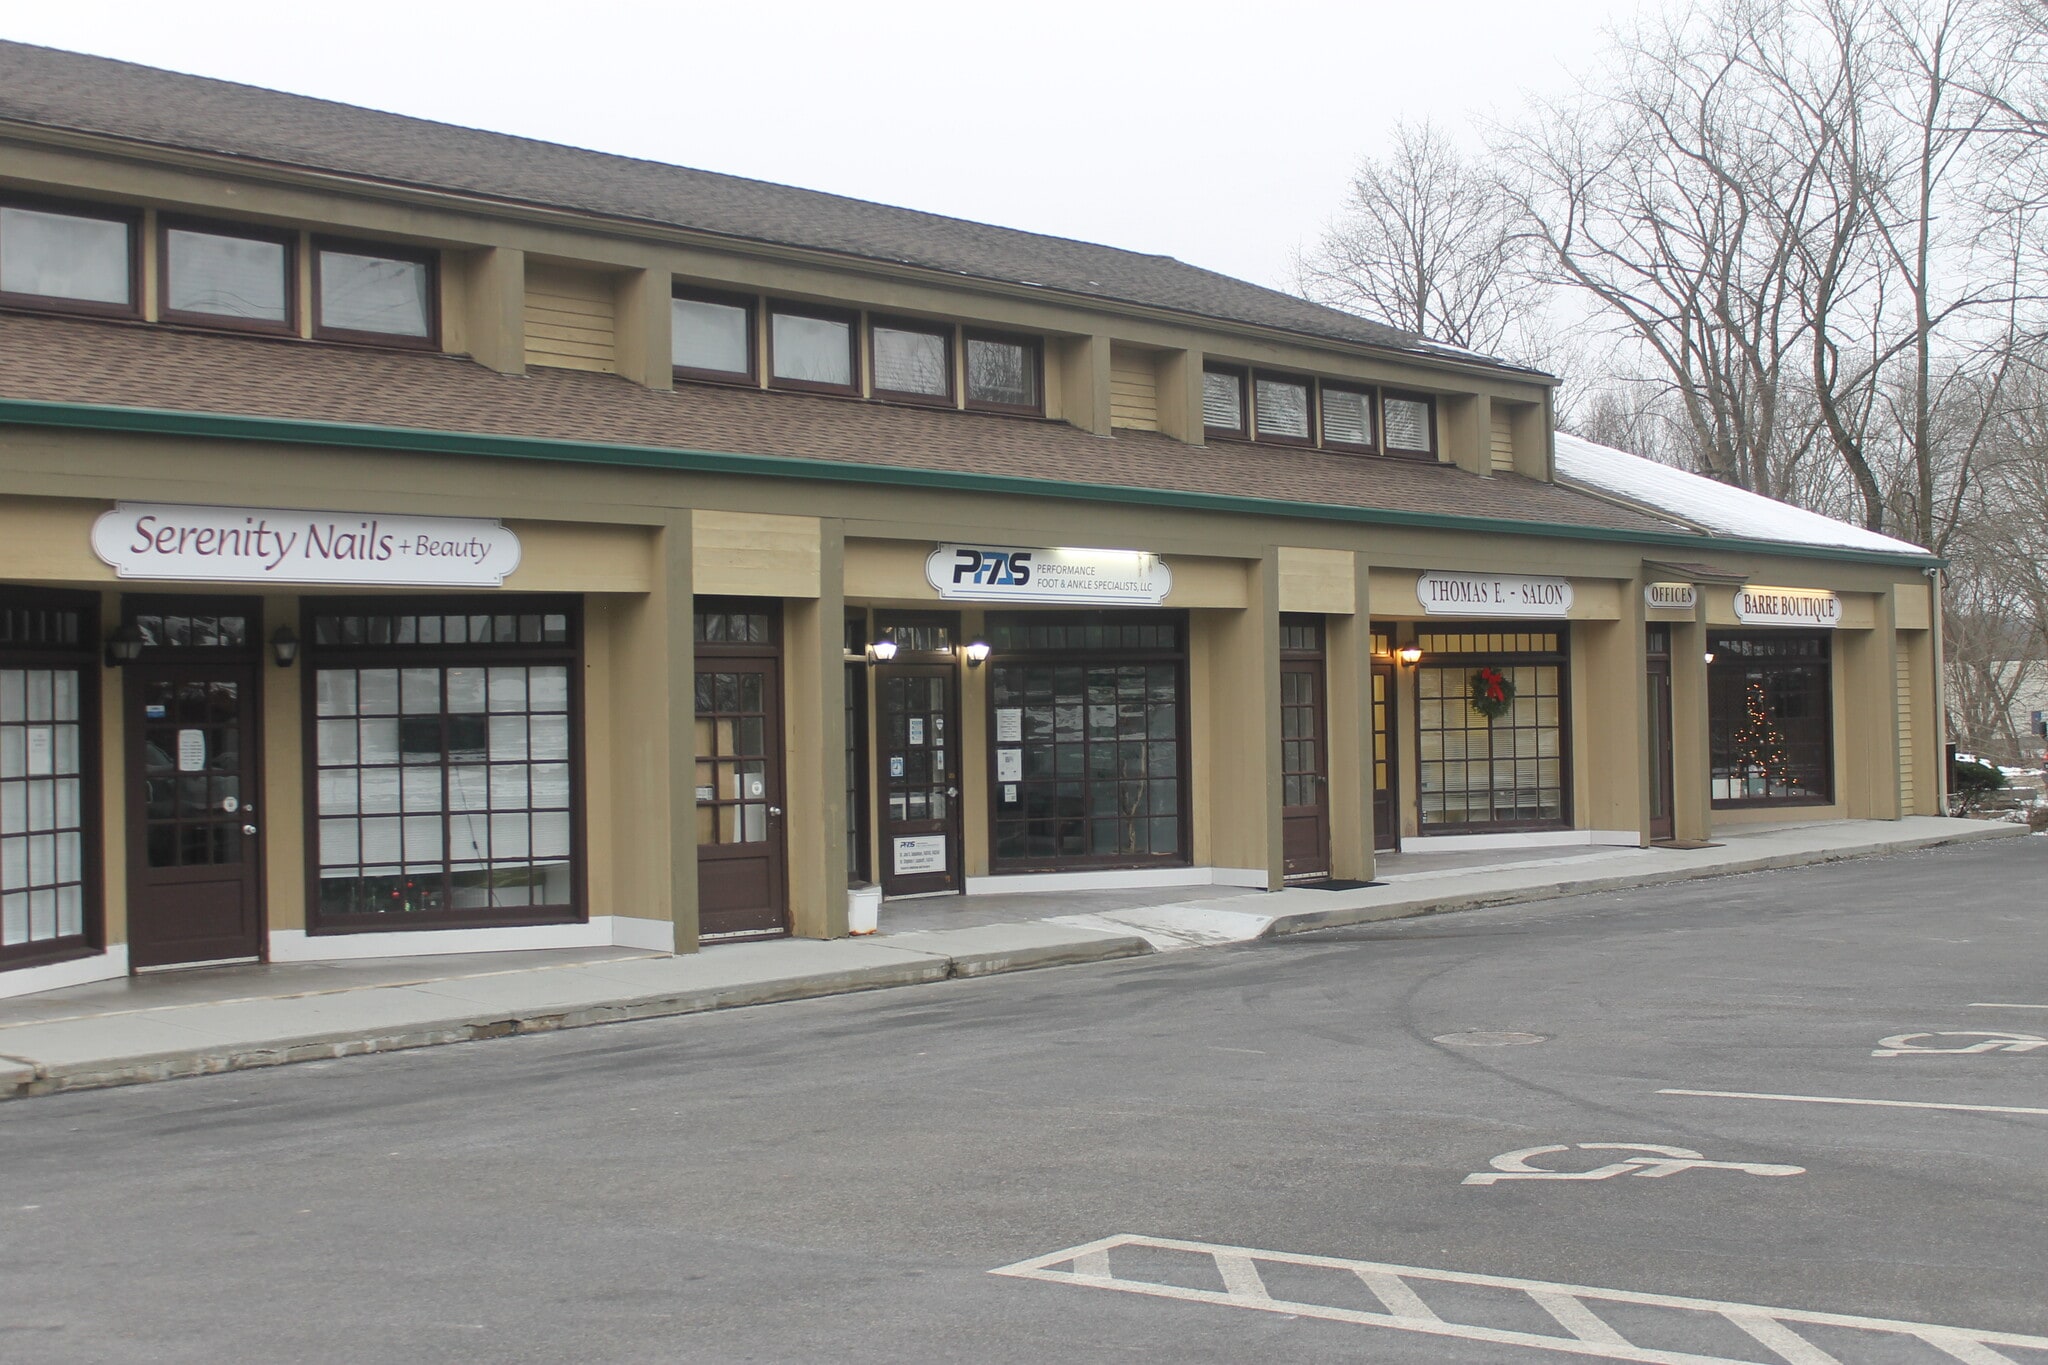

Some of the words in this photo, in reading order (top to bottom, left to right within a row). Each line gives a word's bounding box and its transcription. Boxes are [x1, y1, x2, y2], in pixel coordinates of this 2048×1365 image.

[130, 515, 297, 570] Serenity
[305, 520, 393, 560] Nails
[416, 535, 492, 565] Beauty
[953, 549, 1032, 586] PFAS
[1036, 564, 1096, 576] PERFORMANCE
[1037, 578, 1059, 588] FOOT
[1060, 579, 1066, 589] &
[1067, 579, 1092, 590] ANKLE
[1093, 580, 1139, 592] SPECIALISTS,
[1140, 582, 1152, 592] LLC
[1429, 580, 1488, 603] THOMAS
[1494, 582, 1505, 604] E.
[1522, 583, 1563, 605] SALON
[1651, 586, 1693, 603] OFFICES
[1744, 594, 1778, 615] BARRE
[1781, 596, 1835, 622] BOUTIQUE
